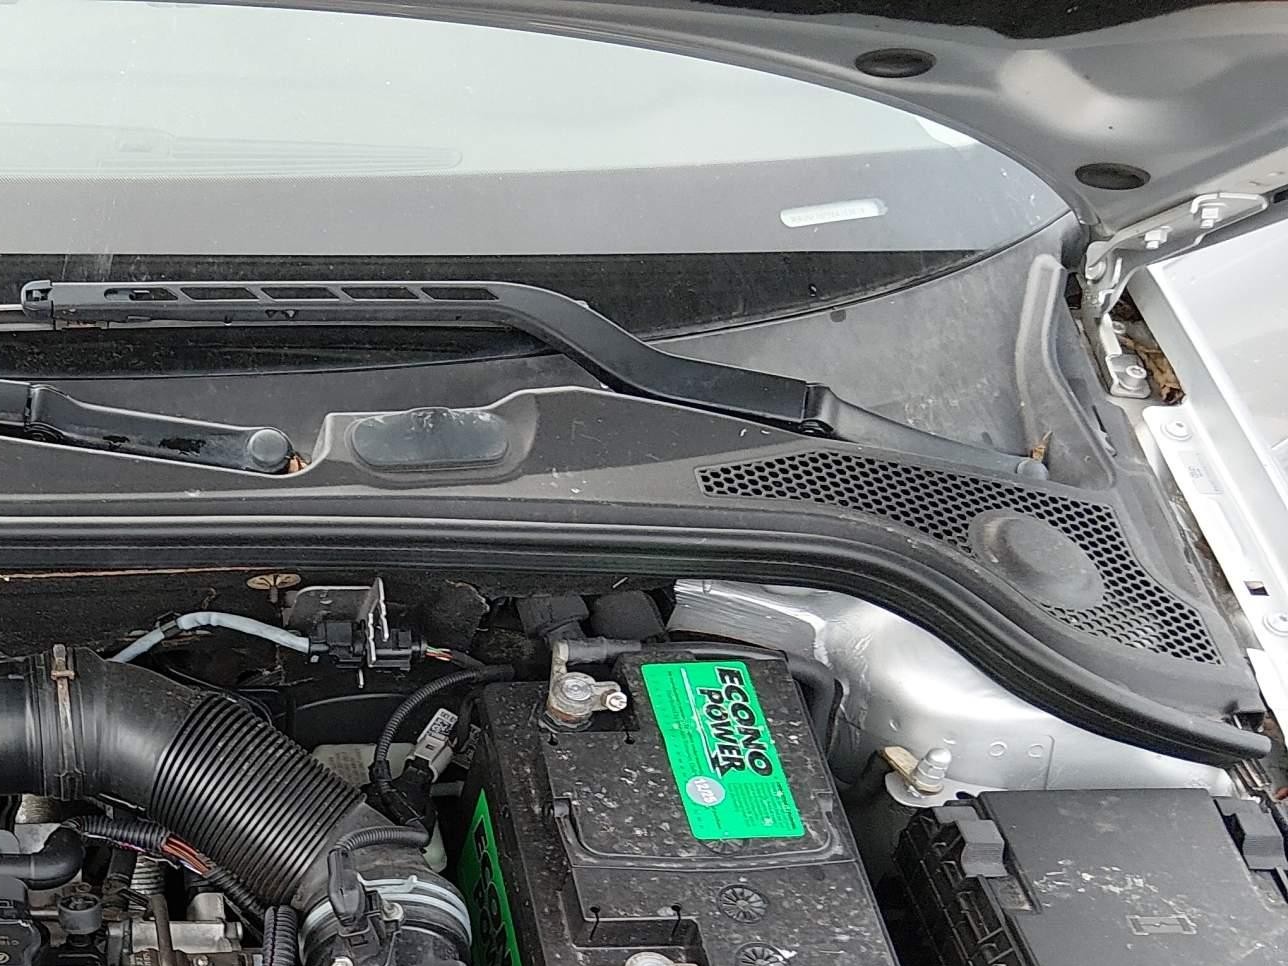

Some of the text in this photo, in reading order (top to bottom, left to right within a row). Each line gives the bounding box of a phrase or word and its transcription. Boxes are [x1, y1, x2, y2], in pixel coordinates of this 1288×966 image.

[696, 686, 747, 778] POWER
[715, 667, 775, 776] ECONO
[693, 776, 718, 805] 12/25
